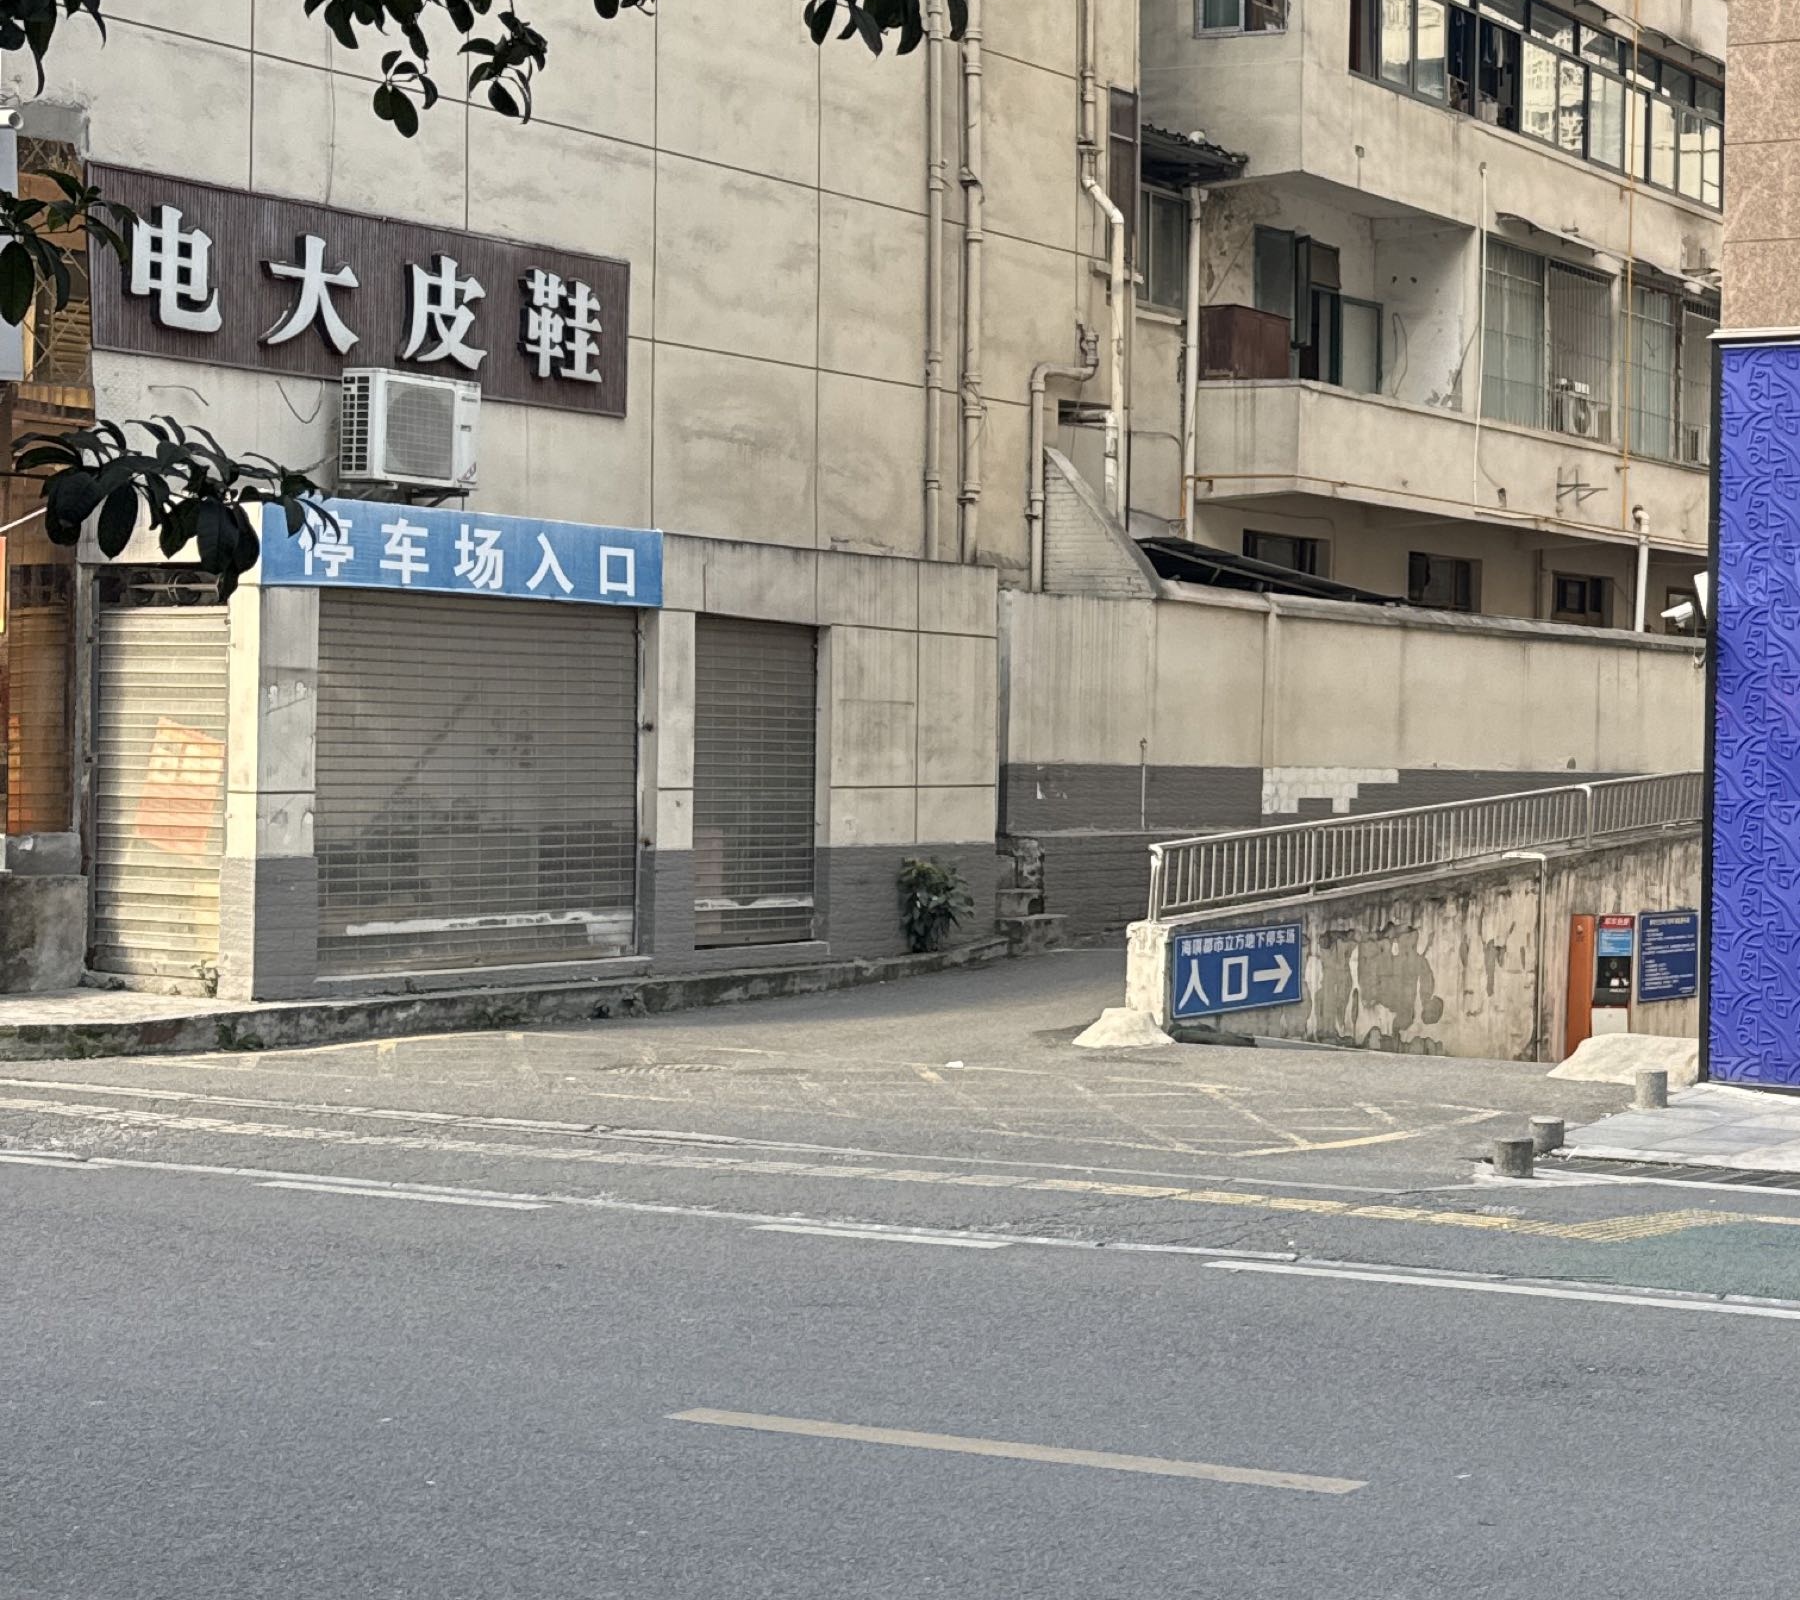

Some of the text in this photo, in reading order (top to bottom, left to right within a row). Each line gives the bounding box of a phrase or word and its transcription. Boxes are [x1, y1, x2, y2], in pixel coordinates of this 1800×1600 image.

[129, 205, 604, 385] 电大皮鞋
[298, 510, 636, 598] 停车场入口
